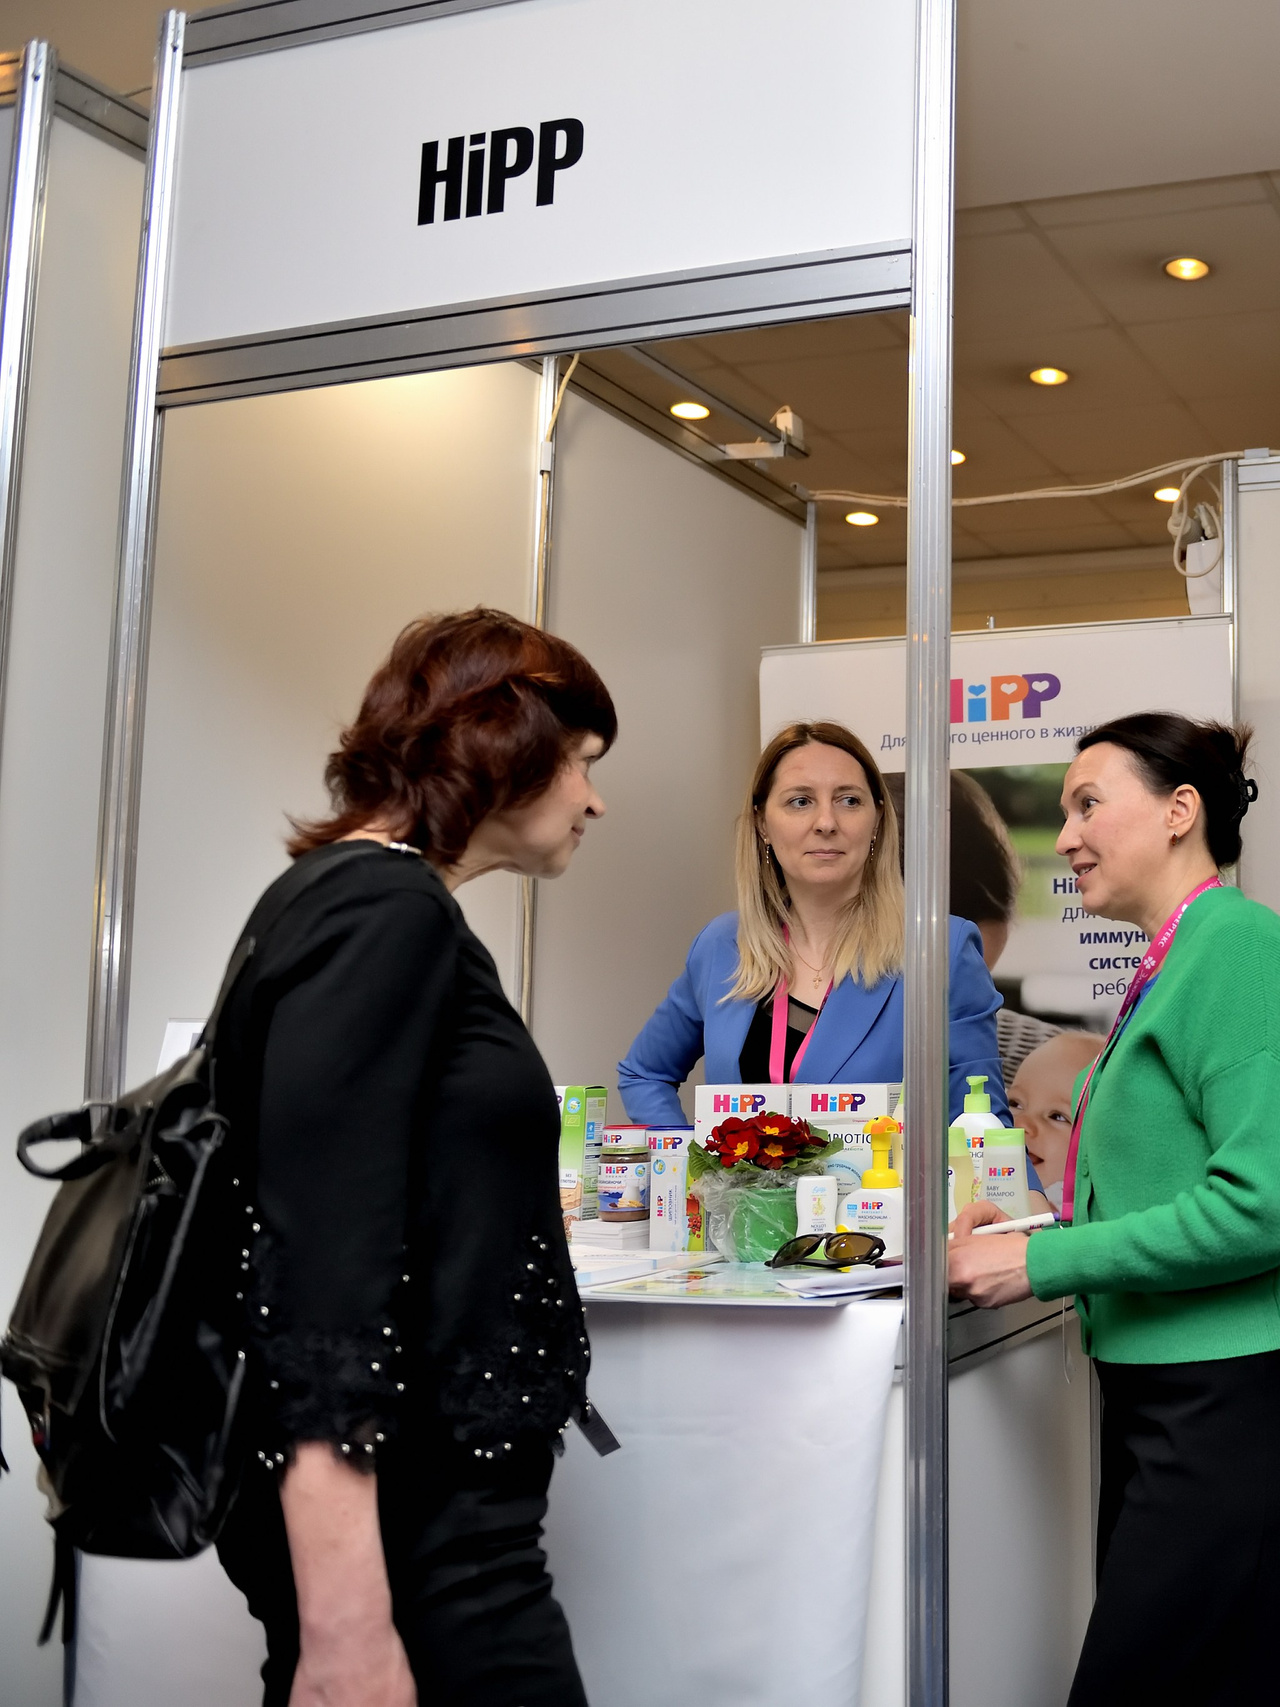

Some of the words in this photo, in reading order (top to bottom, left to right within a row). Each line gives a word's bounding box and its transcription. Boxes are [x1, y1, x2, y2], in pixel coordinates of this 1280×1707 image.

[417, 118, 584, 226] HiPP
[972, 729, 1036, 745] ценного
[1041, 728, 1049, 739] в
[1053, 723, 1098, 739] жизн
[1080, 931, 1151, 948] иммун
[1089, 956, 1142, 970] систе
[714, 1094, 766, 1112] HiPP
[811, 1093, 866, 1112] HiPP
[604, 1135, 622, 1143] HiPP
[648, 1137, 683, 1149] HiPP
[605, 1166, 628, 1174] HiPP
[989, 1167, 1015, 1177] HiPP
[861, 1202, 883, 1210] HiPP
